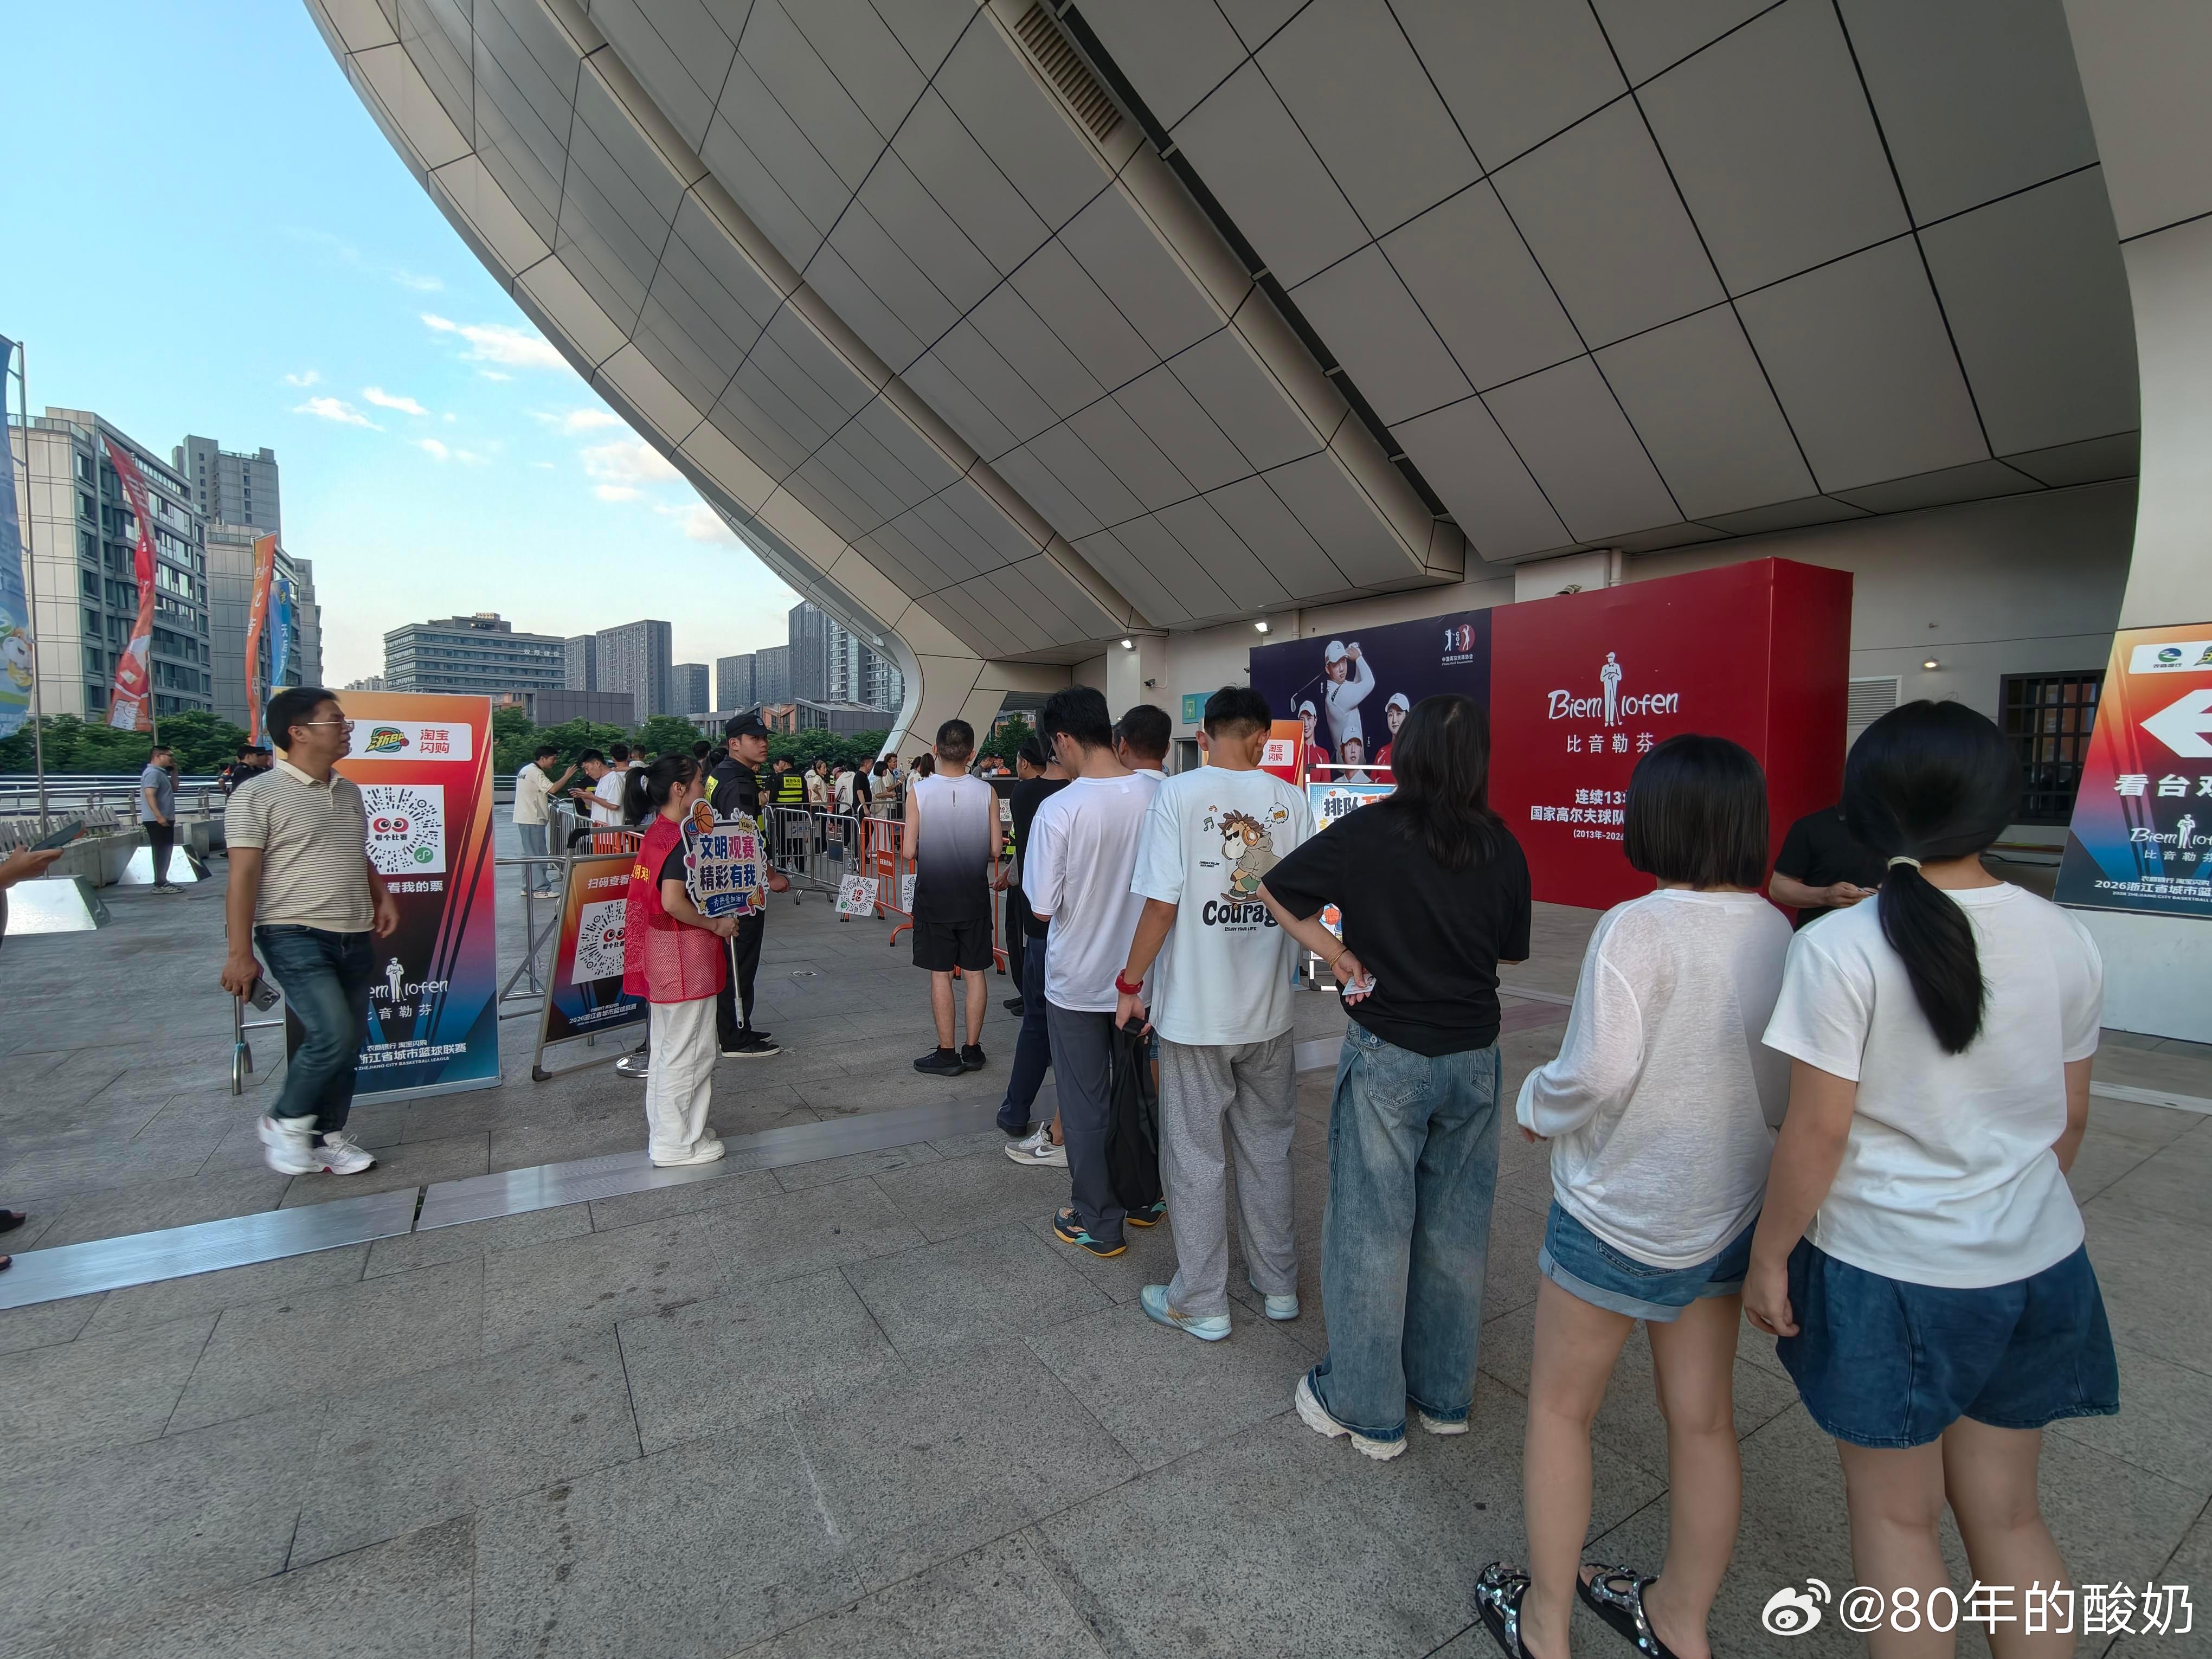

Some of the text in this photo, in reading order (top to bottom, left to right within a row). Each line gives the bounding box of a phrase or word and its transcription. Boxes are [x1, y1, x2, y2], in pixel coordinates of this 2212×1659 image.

[420, 729, 450, 741] 淘宝
[420, 742, 450, 754] 闪购
[1269, 744, 1283, 753] 淘宝
[1566, 732, 1654, 754] 比音勒芬
[1268, 753, 1283, 761] 闪购
[1531, 806, 1624, 825] 国家高尔夫球队
[741, 821, 753, 830] YEAH!
[699, 835, 755, 860] 文明观赛
[2144, 849, 2212, 862] 比音勒芬
[699, 864, 756, 891] 精彩有我
[387, 880, 443, 893] 看我的票
